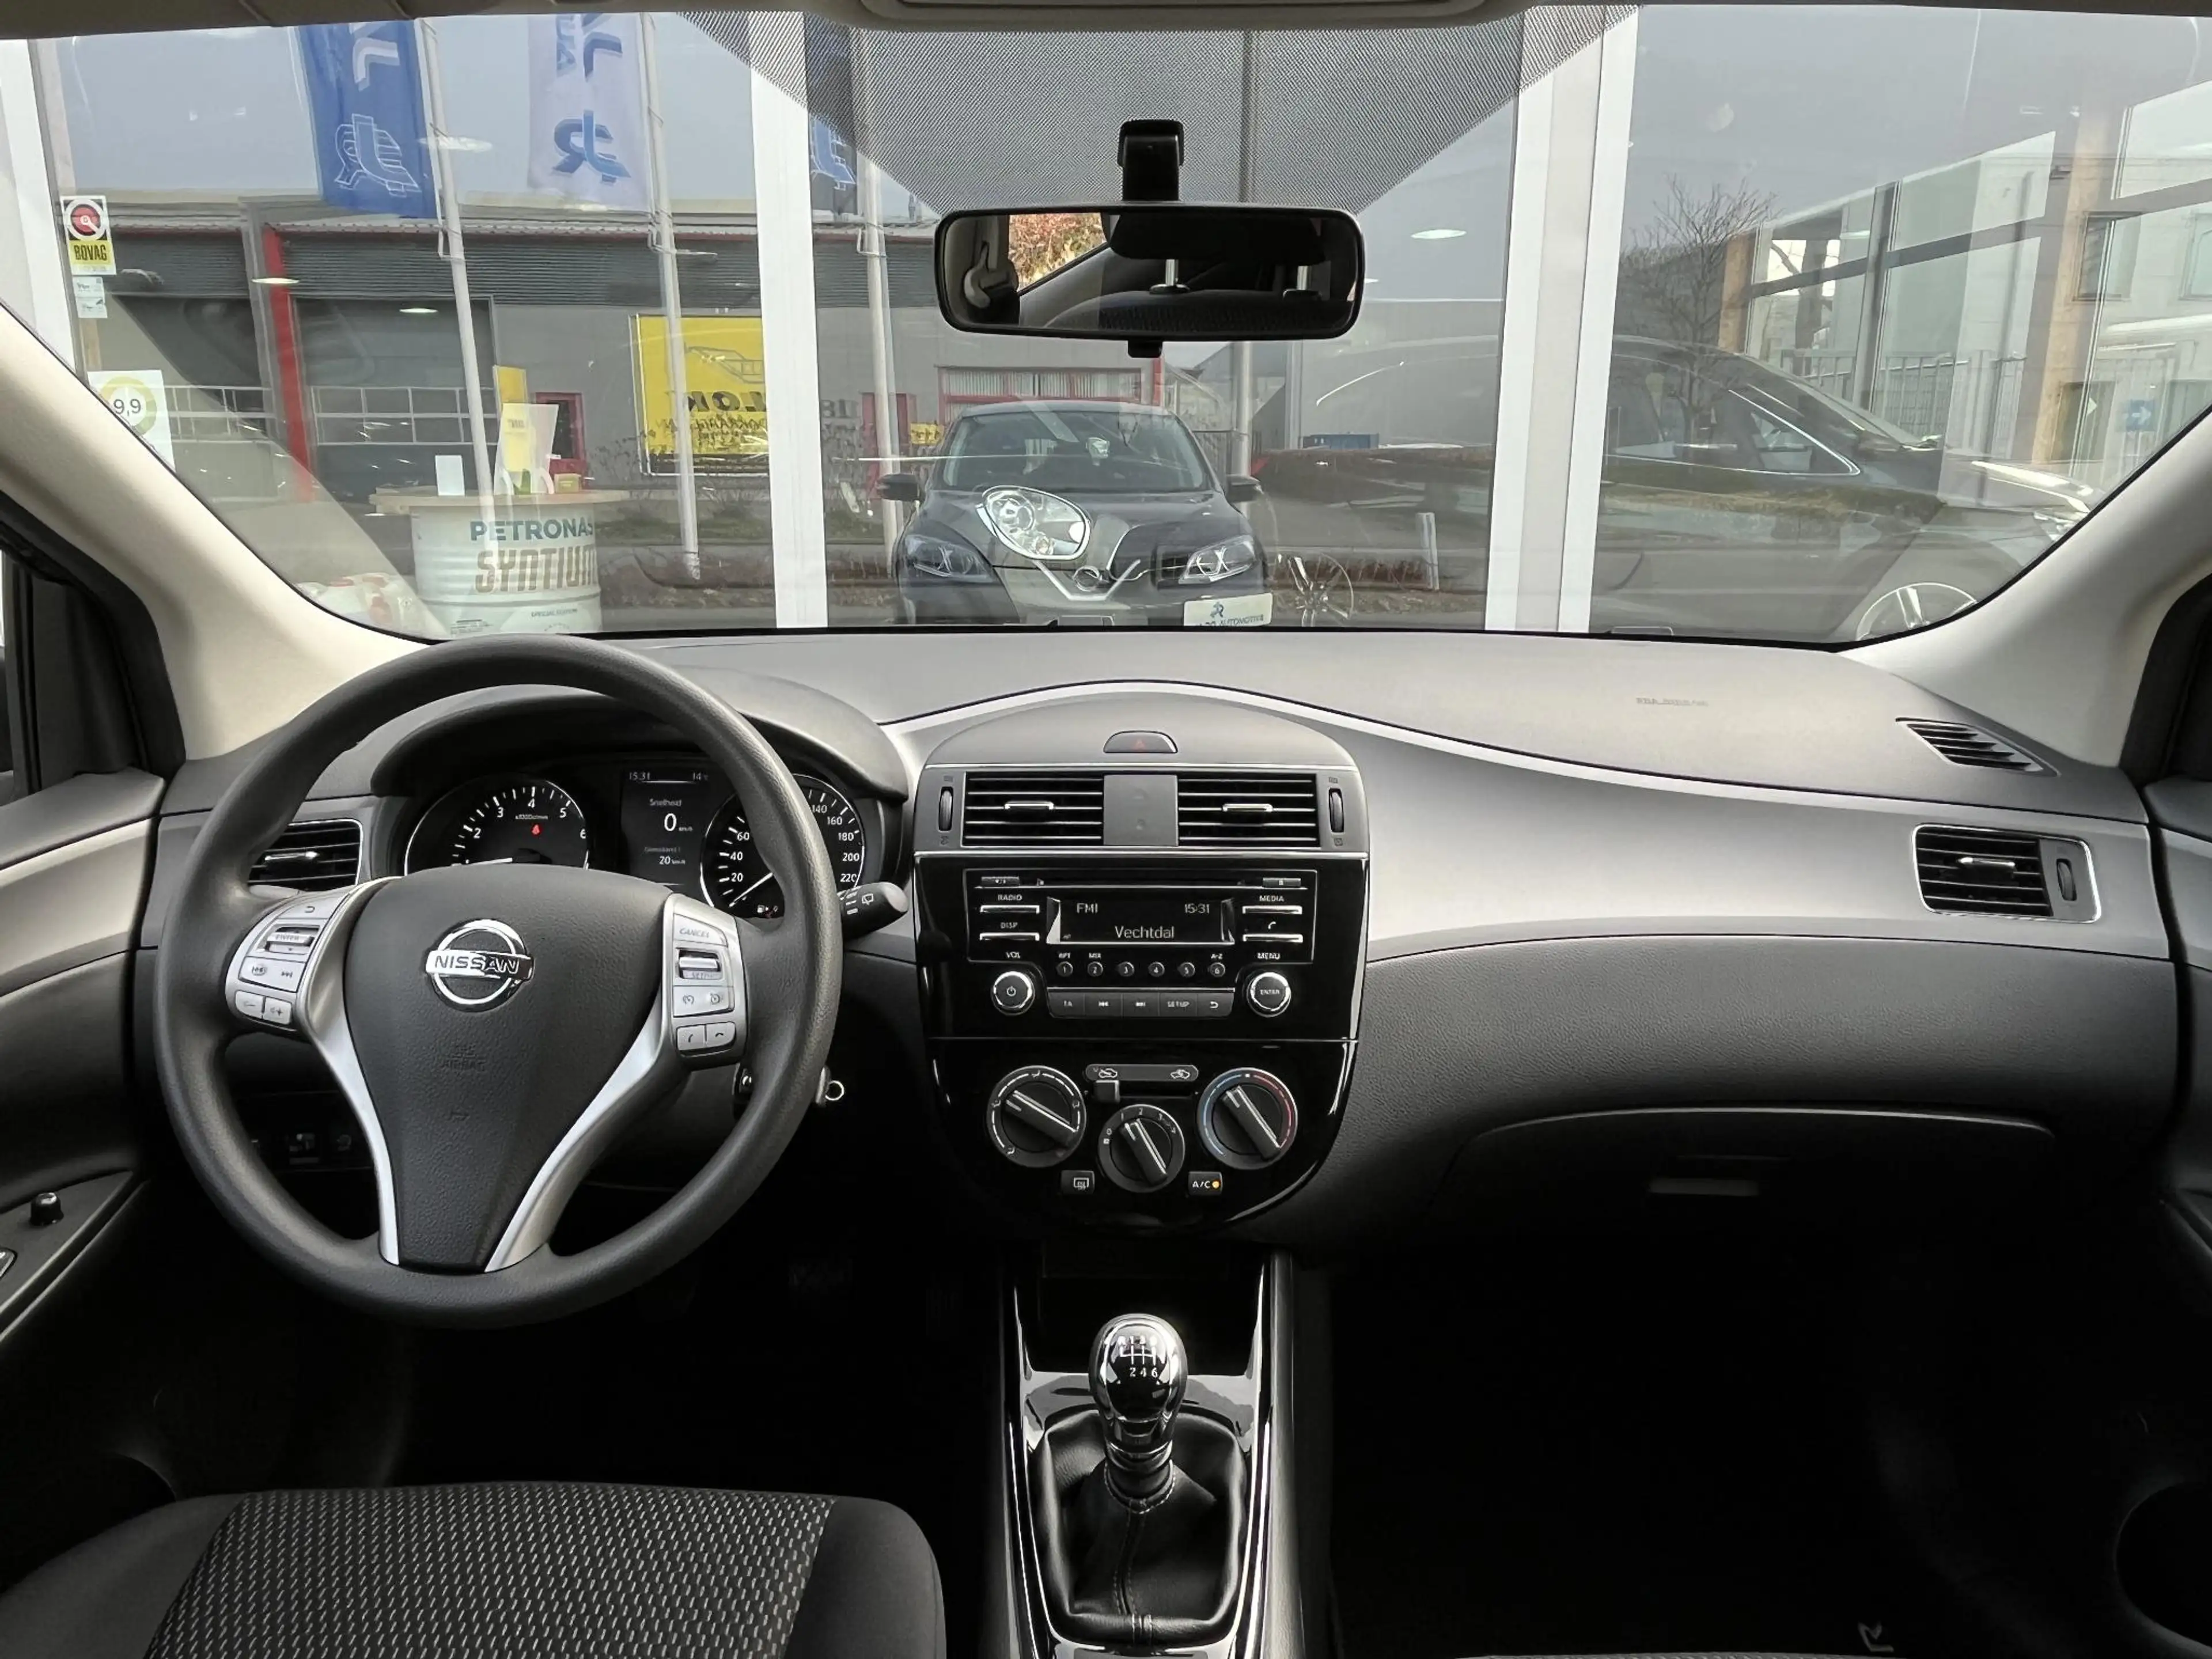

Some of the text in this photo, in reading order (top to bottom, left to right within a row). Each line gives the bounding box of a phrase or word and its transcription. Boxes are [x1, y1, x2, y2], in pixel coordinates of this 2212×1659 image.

[73, 244, 108, 261] BOVAG
[113, 398, 142, 416] 9,9
[469, 517, 594, 541] PETRONAS
[528, 798, 536, 808] 4
[497, 806, 505, 818] 3
[559, 807, 567, 818] 5
[811, 804, 828, 813] 140
[664, 812, 677, 832] 0
[826, 816, 843, 825] 160
[473, 827, 482, 839] 2
[579, 830, 586, 839] 6
[737, 831, 750, 841] 60
[838, 832, 855, 842] 180
[658, 855, 671, 865] 20
[729, 851, 744, 861] 40
[842, 853, 860, 862] 200
[730, 872, 744, 882] 20
[839, 873, 858, 883] 220
[1114, 925, 1175, 939] Vechtdal
[1006, 951, 1021, 959] VOL
[1257, 952, 1281, 960] MENU
[434, 955, 519, 975] NISSAN
[1192, 1181, 1211, 1189] A/C
[1129, 1367, 1136, 1377] 2
[1151, 1367, 1158, 1378] 6
